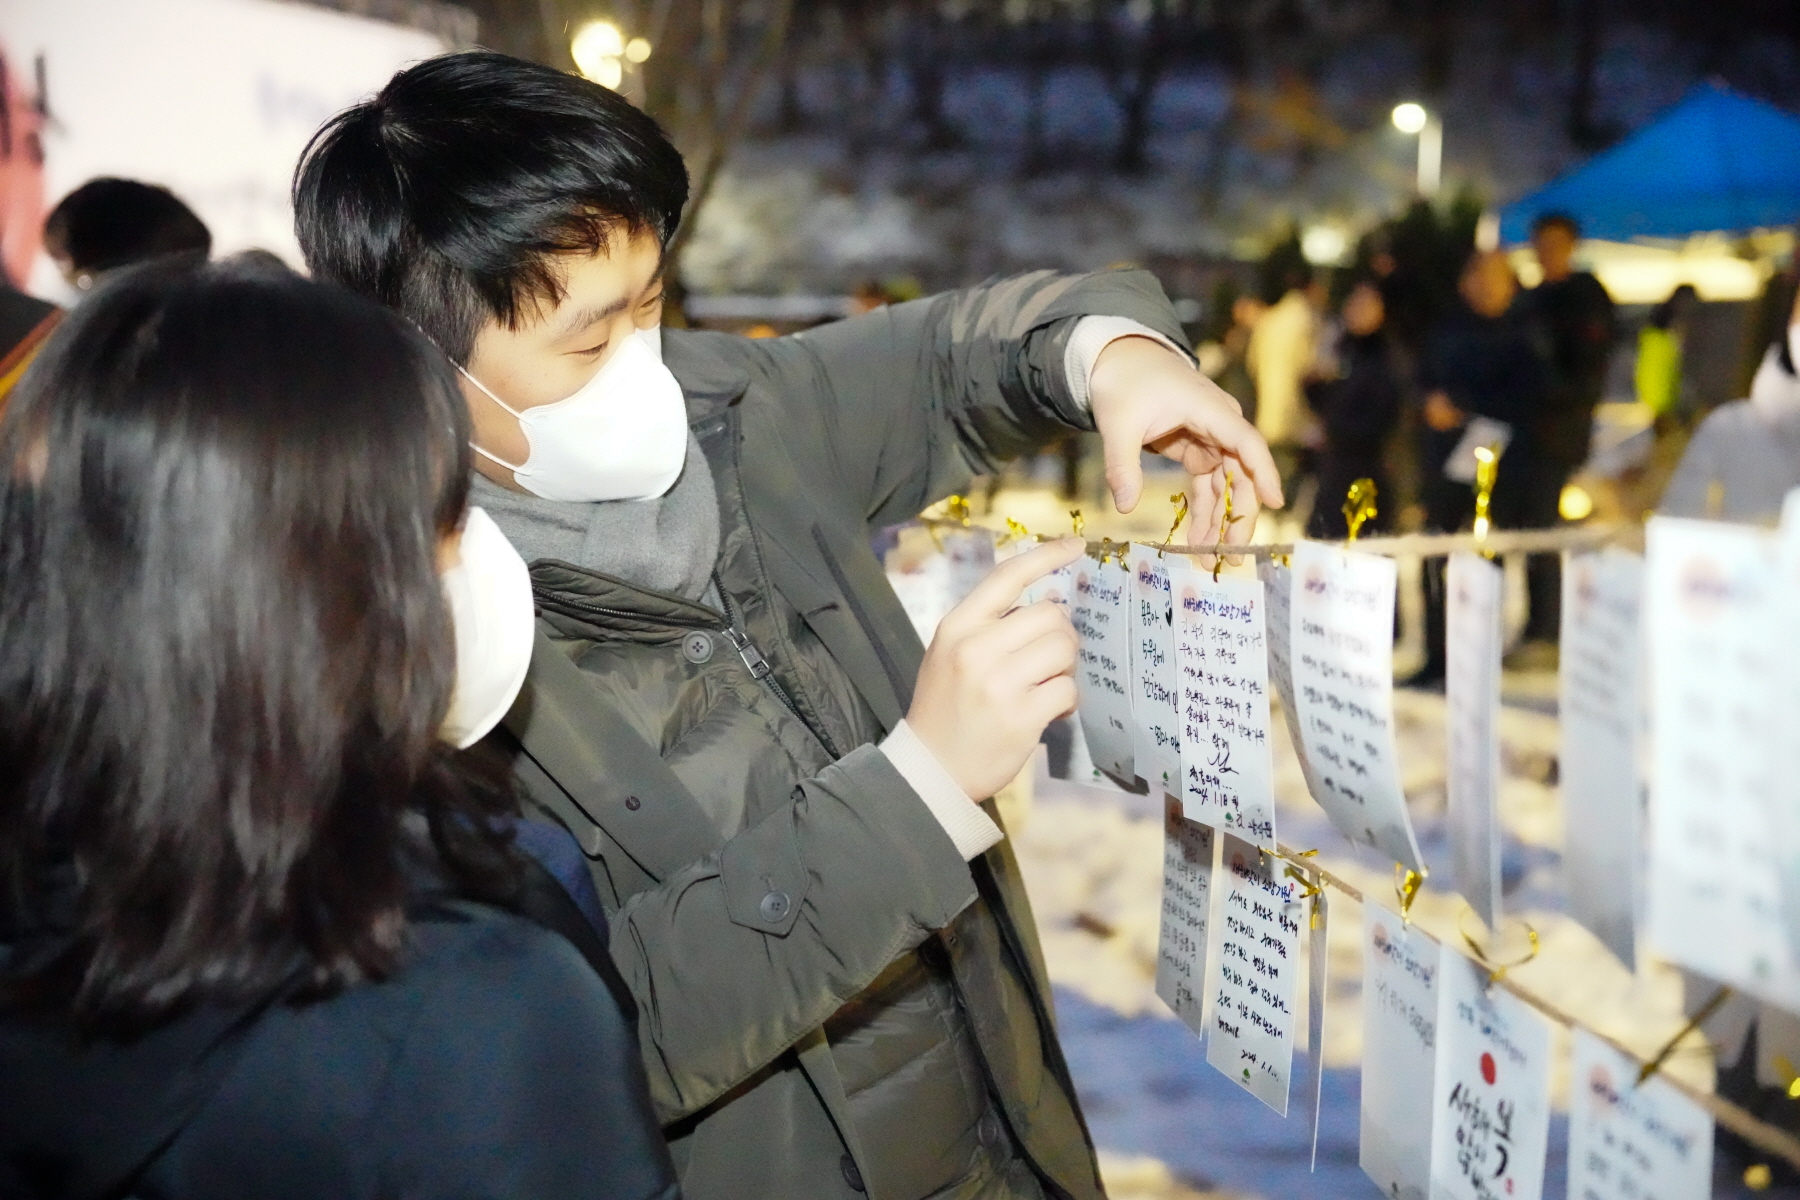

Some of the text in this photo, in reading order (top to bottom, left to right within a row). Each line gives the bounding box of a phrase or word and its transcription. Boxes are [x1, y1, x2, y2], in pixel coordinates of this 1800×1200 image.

[1139, 570, 1162, 590] 새해맞이
[1183, 598, 1252, 624] 새해맞이 소망기원
[1142, 638, 1165, 668] 5월에
[1232, 862, 1260, 886] 새해맞이
[1262, 877, 1291, 904] 소망기원
